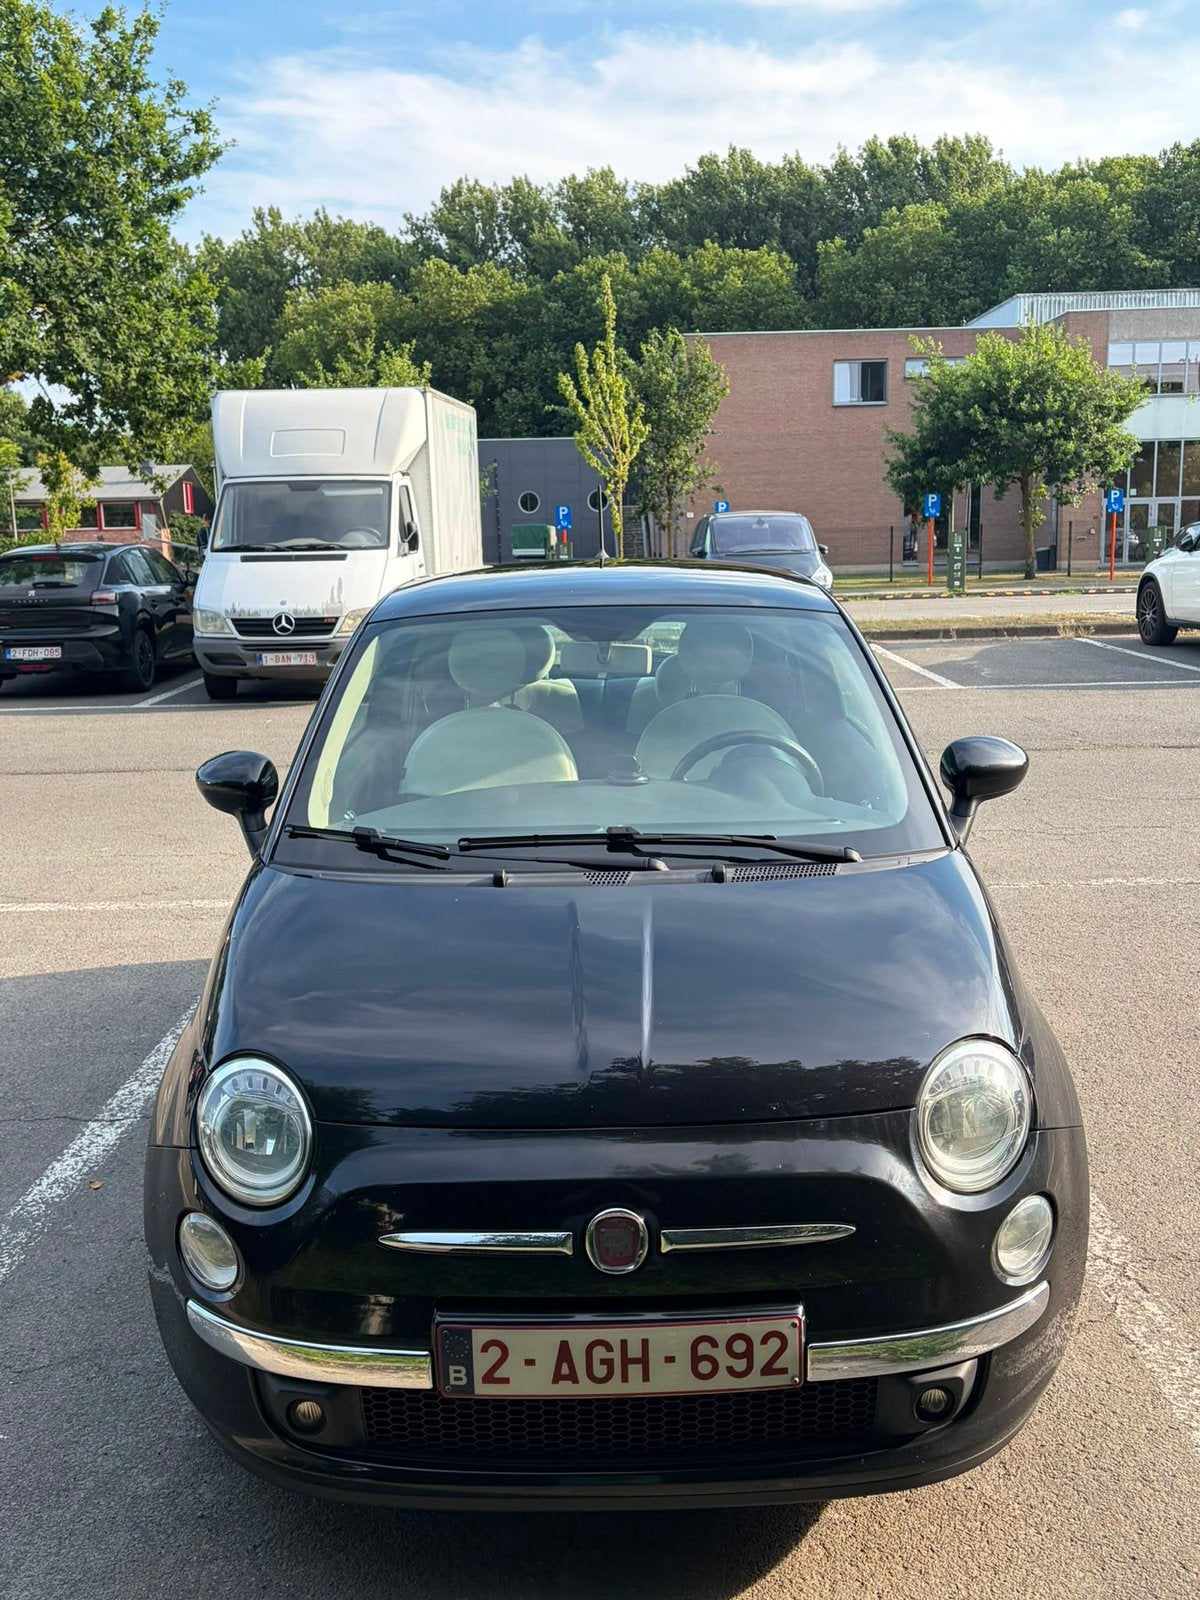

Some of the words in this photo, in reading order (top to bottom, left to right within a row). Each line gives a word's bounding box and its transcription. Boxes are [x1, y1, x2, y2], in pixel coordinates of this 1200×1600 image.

[928, 494, 938, 507] P
[1111, 490, 1120, 503] P
[559, 506, 569, 520] P
[718, 502, 727, 512] P
[449, 1365, 468, 1386] B
[479, 1330, 789, 1385] 2-AGH-692
